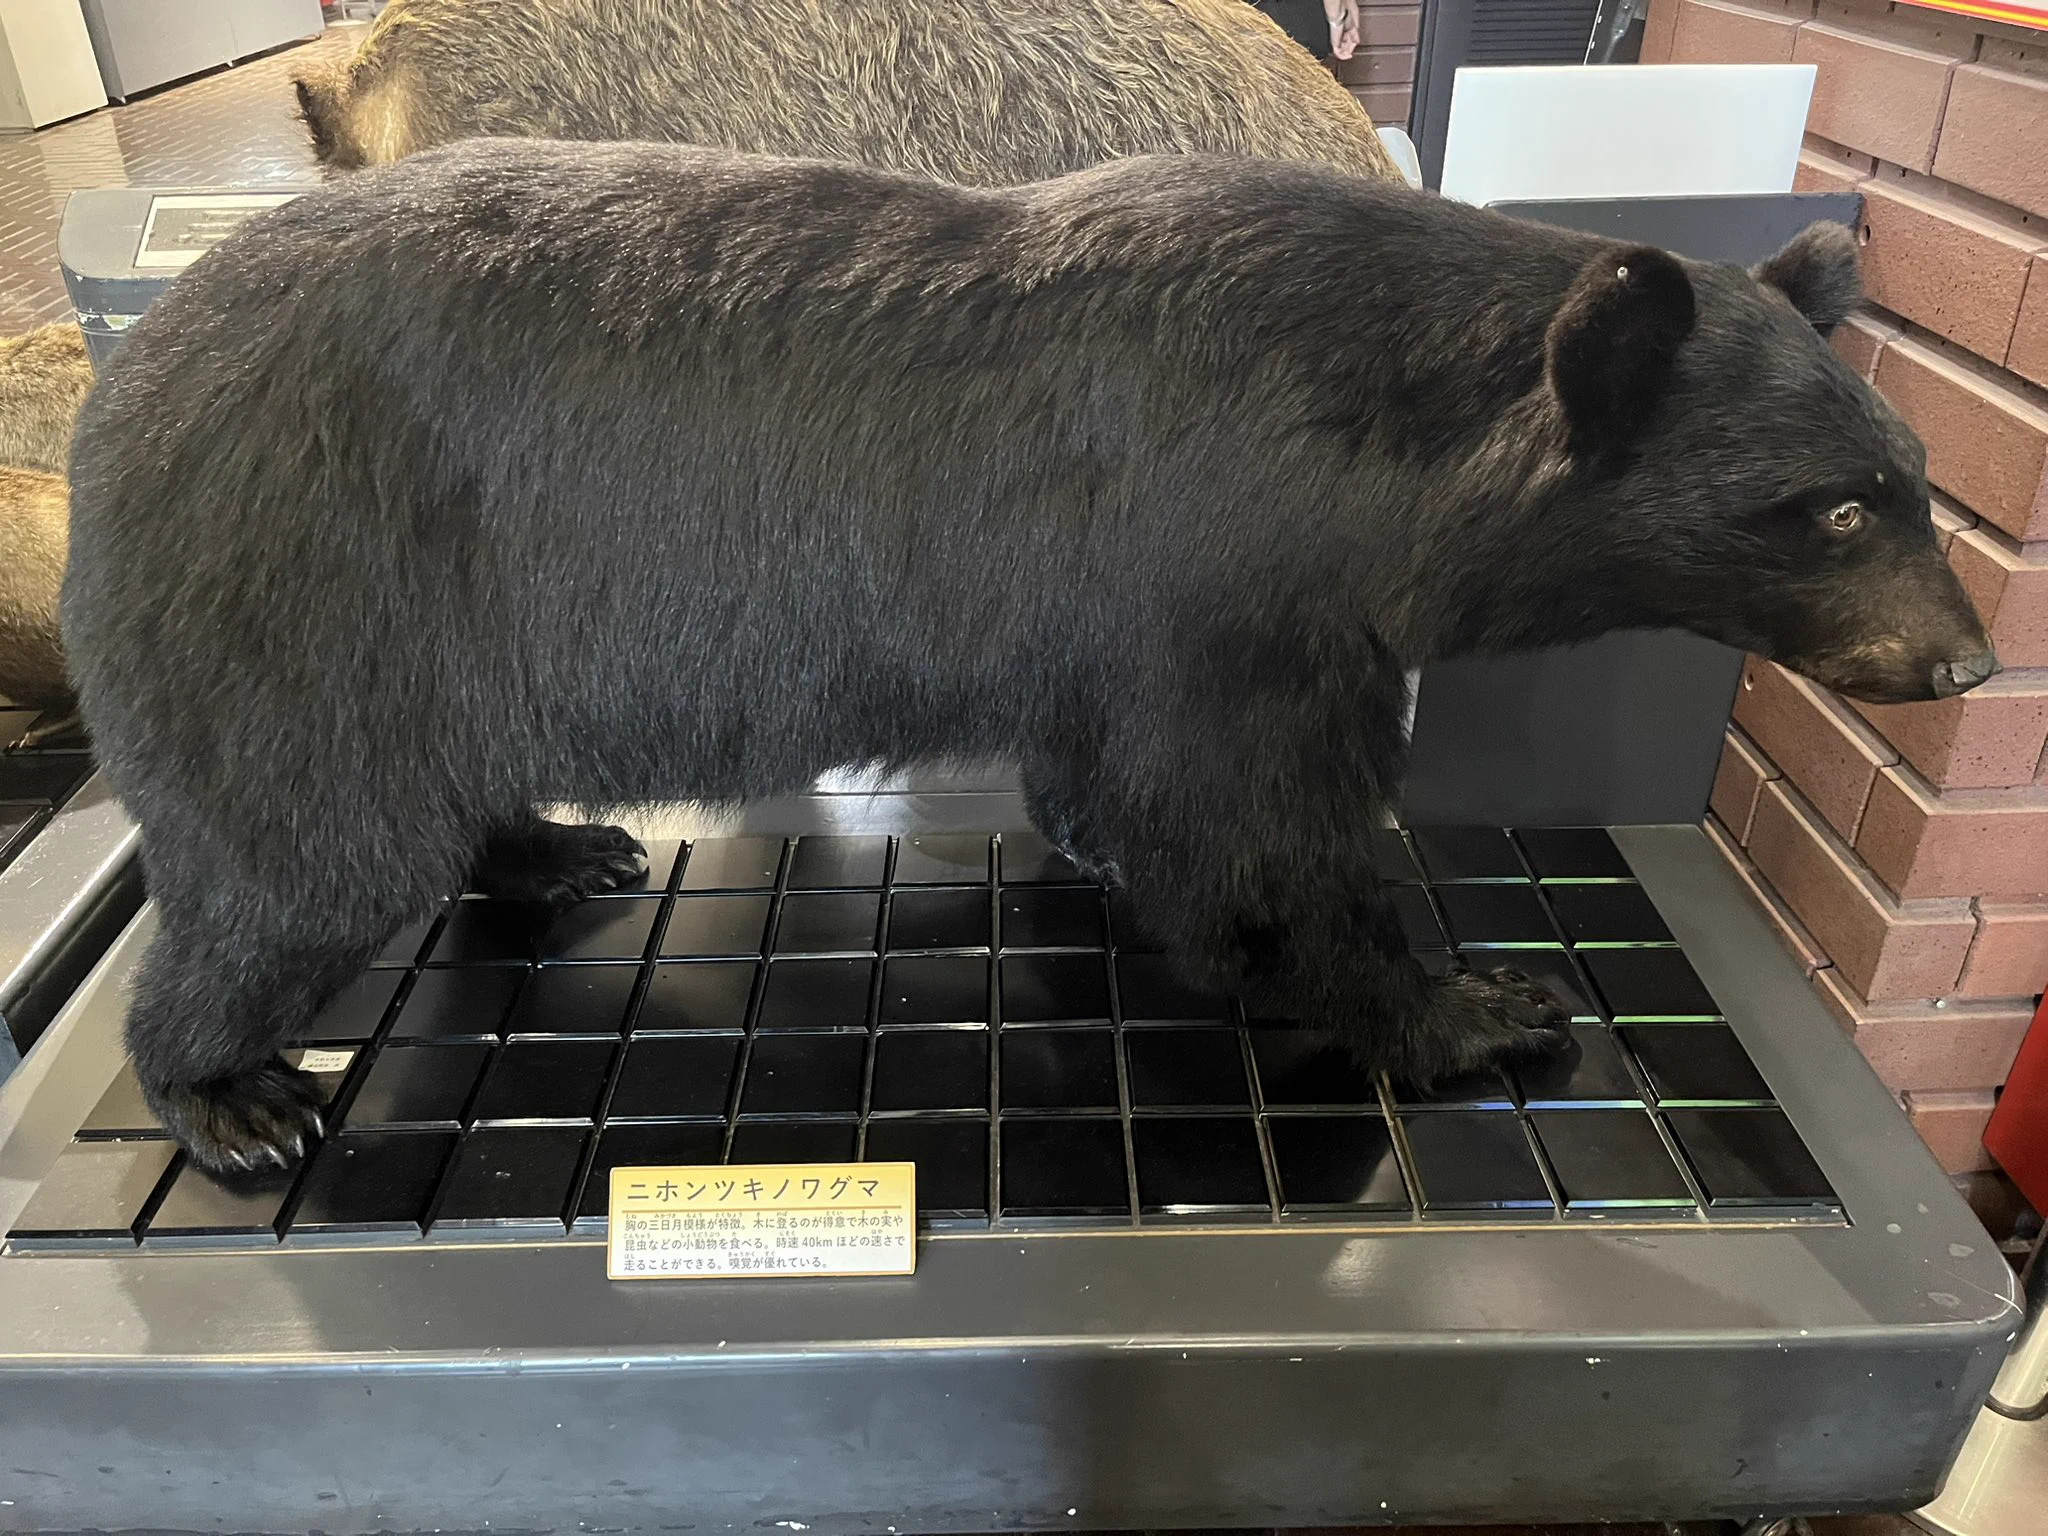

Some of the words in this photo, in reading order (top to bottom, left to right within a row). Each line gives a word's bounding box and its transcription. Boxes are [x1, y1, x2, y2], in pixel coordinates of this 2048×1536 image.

[627, 1175, 879, 1202] ニホンツキノワグマ
[625, 1215, 903, 1231] 胸の三日月模様が特徴。木に登るのが得意で木の実や
